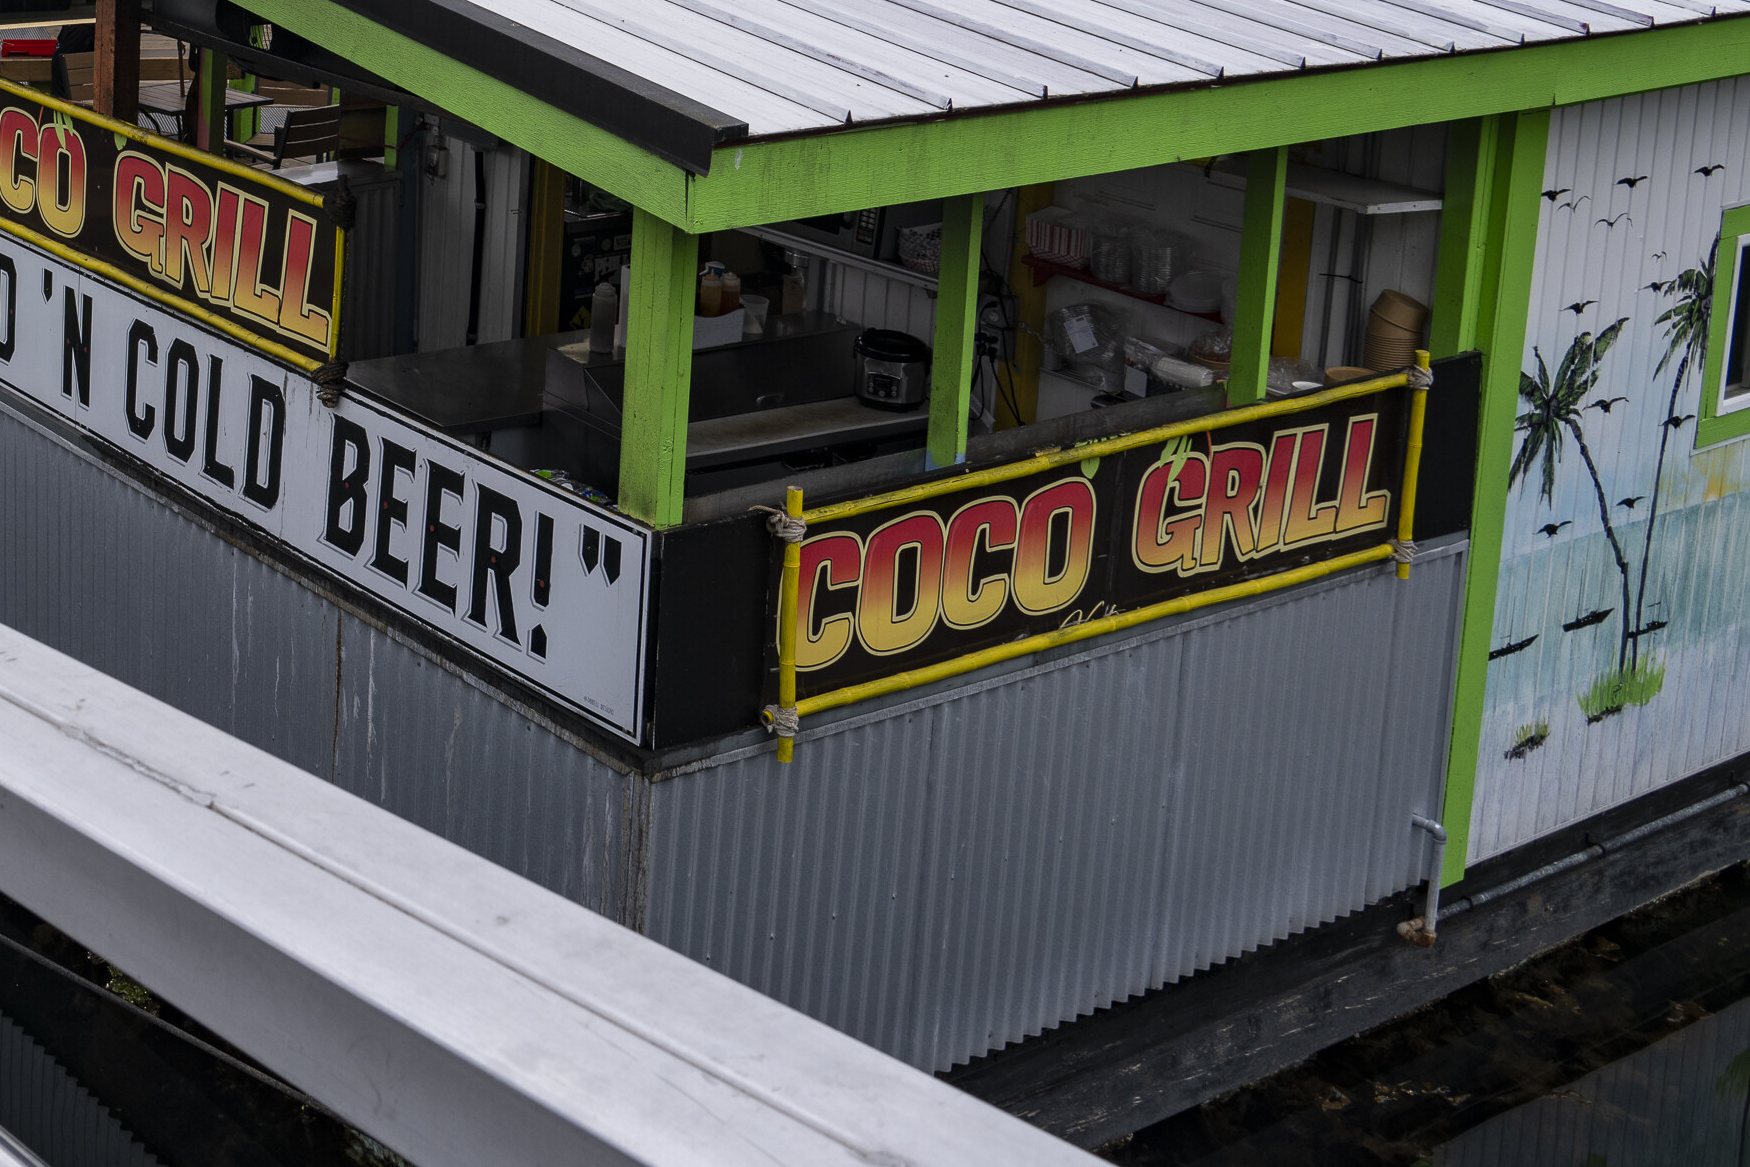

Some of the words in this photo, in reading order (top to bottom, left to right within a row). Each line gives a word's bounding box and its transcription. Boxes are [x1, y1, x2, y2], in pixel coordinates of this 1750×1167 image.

[112, 149, 332, 355] GRILL
[41, 267, 93, 411] 'N
[124, 317, 285, 513] COLD
[317, 412, 623, 664] BEER!"
[777, 475, 1097, 673] COCO
[1131, 412, 1392, 579] GRILL
